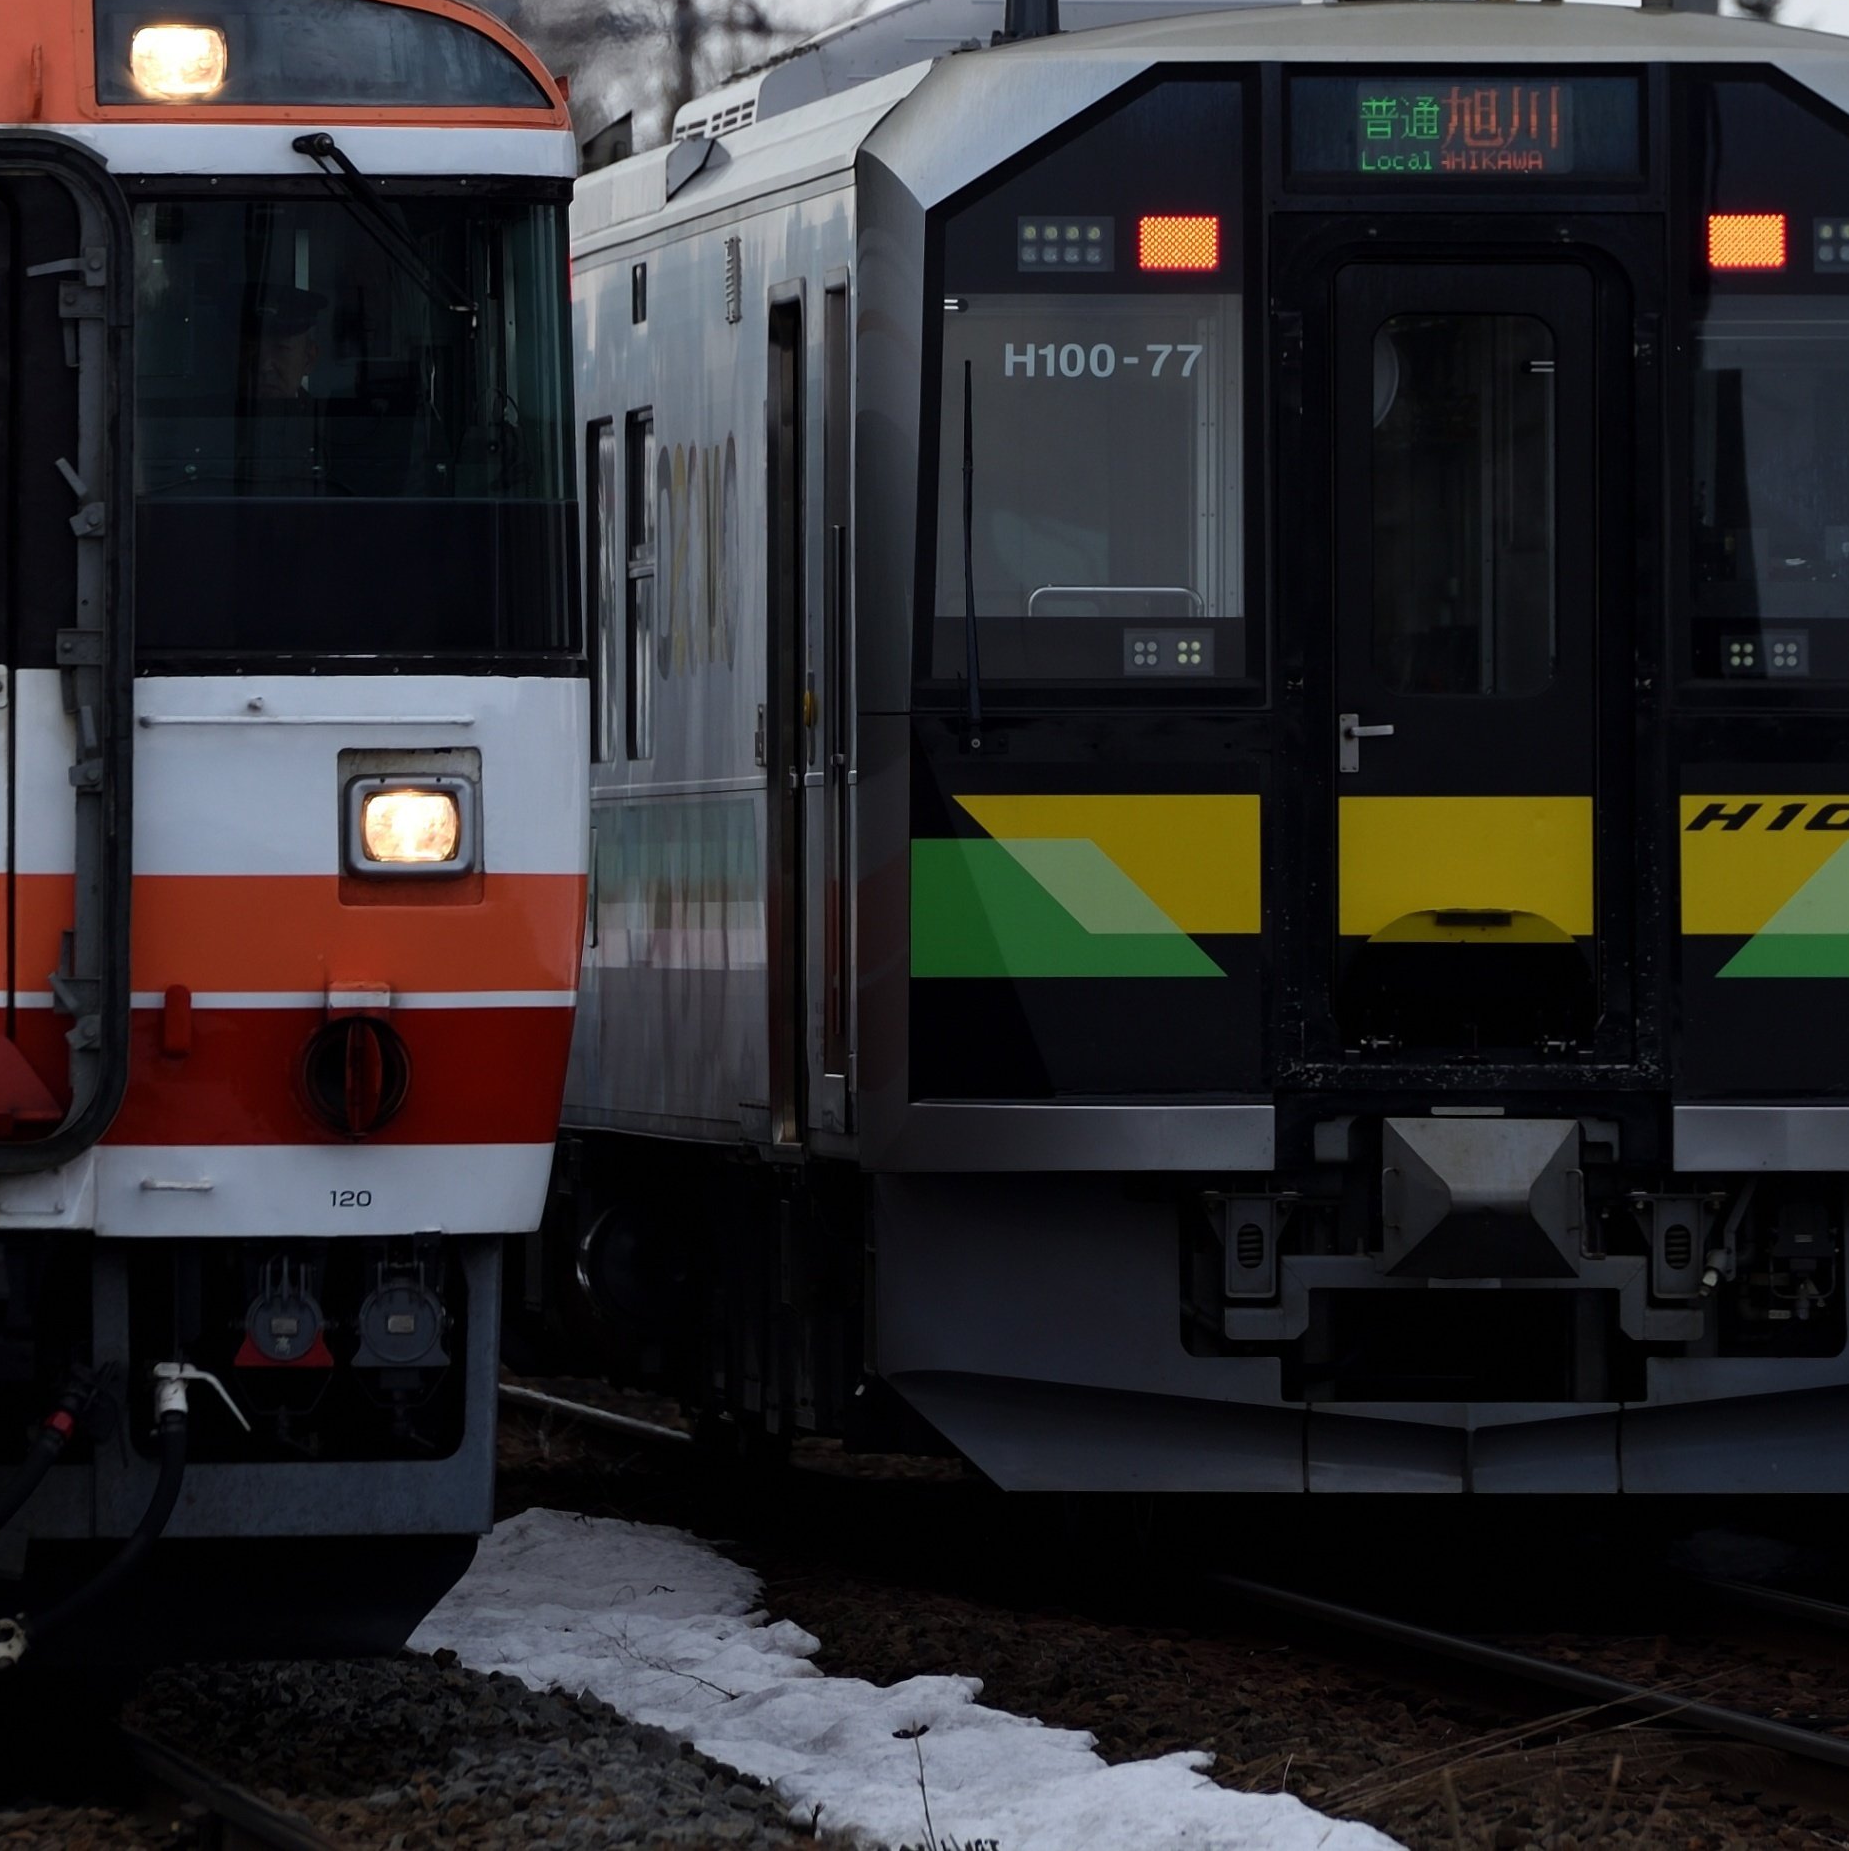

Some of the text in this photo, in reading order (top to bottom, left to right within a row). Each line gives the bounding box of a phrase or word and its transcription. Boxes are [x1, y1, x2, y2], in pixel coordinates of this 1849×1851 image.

[1359, 86, 1561, 149] 普通 旭川
[1362, 151, 1432, 171] Local
[1004, 343, 1203, 377] H100-77
[329, 1189, 372, 1207] 120
